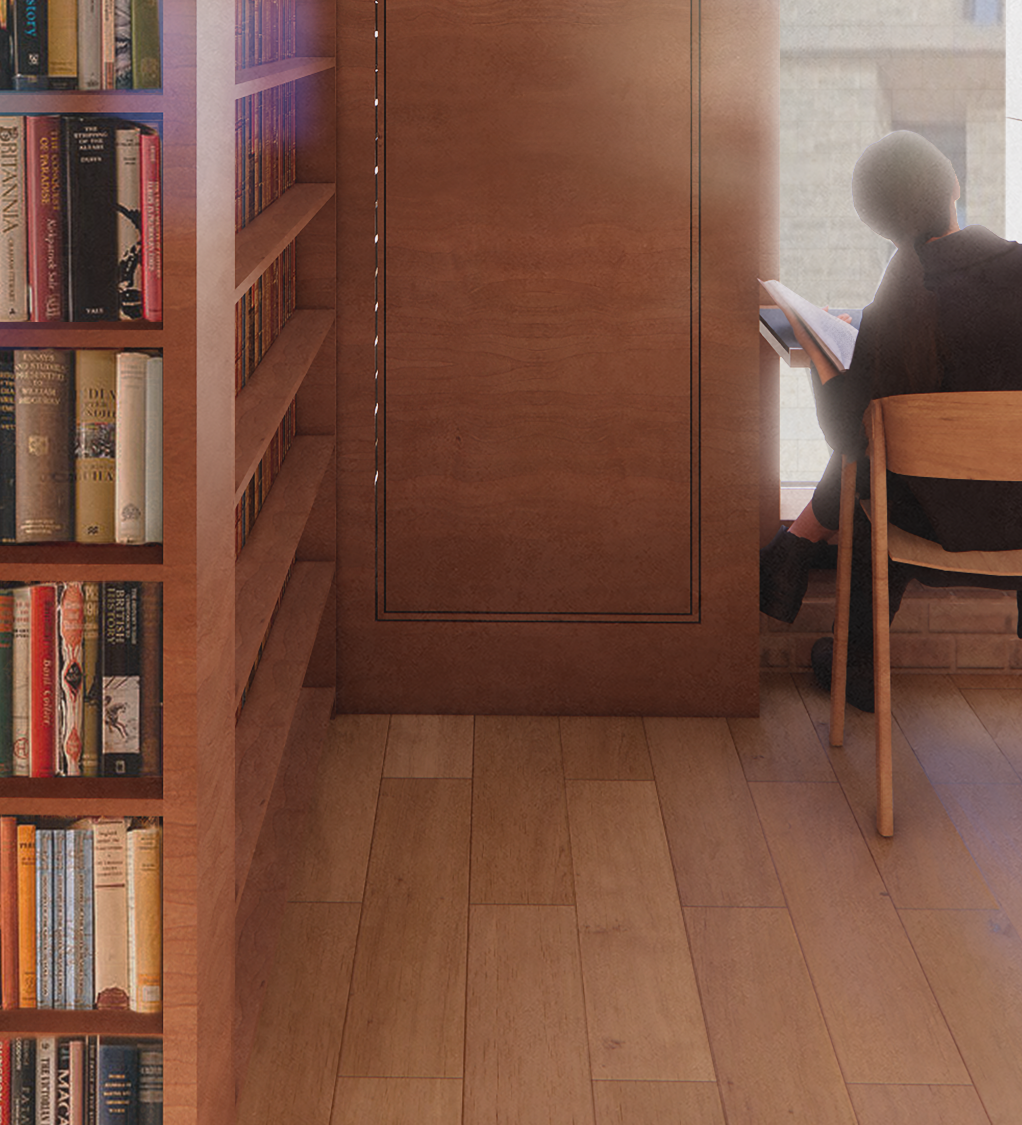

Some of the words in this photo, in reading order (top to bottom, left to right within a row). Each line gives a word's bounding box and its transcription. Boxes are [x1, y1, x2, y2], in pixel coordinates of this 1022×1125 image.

[40, 137, 50, 150] OF
[0, 126, 19, 233] BRITANNIA
[40, 154, 50, 204] PARADISE
[50, 154, 60, 210] CONQUEST
[23, 353, 55, 362] ESSAYS
[106, 588, 116, 645] HISTORY
[116, 589, 125, 643] BRITISH
[41, 1058, 50, 1073] THE
